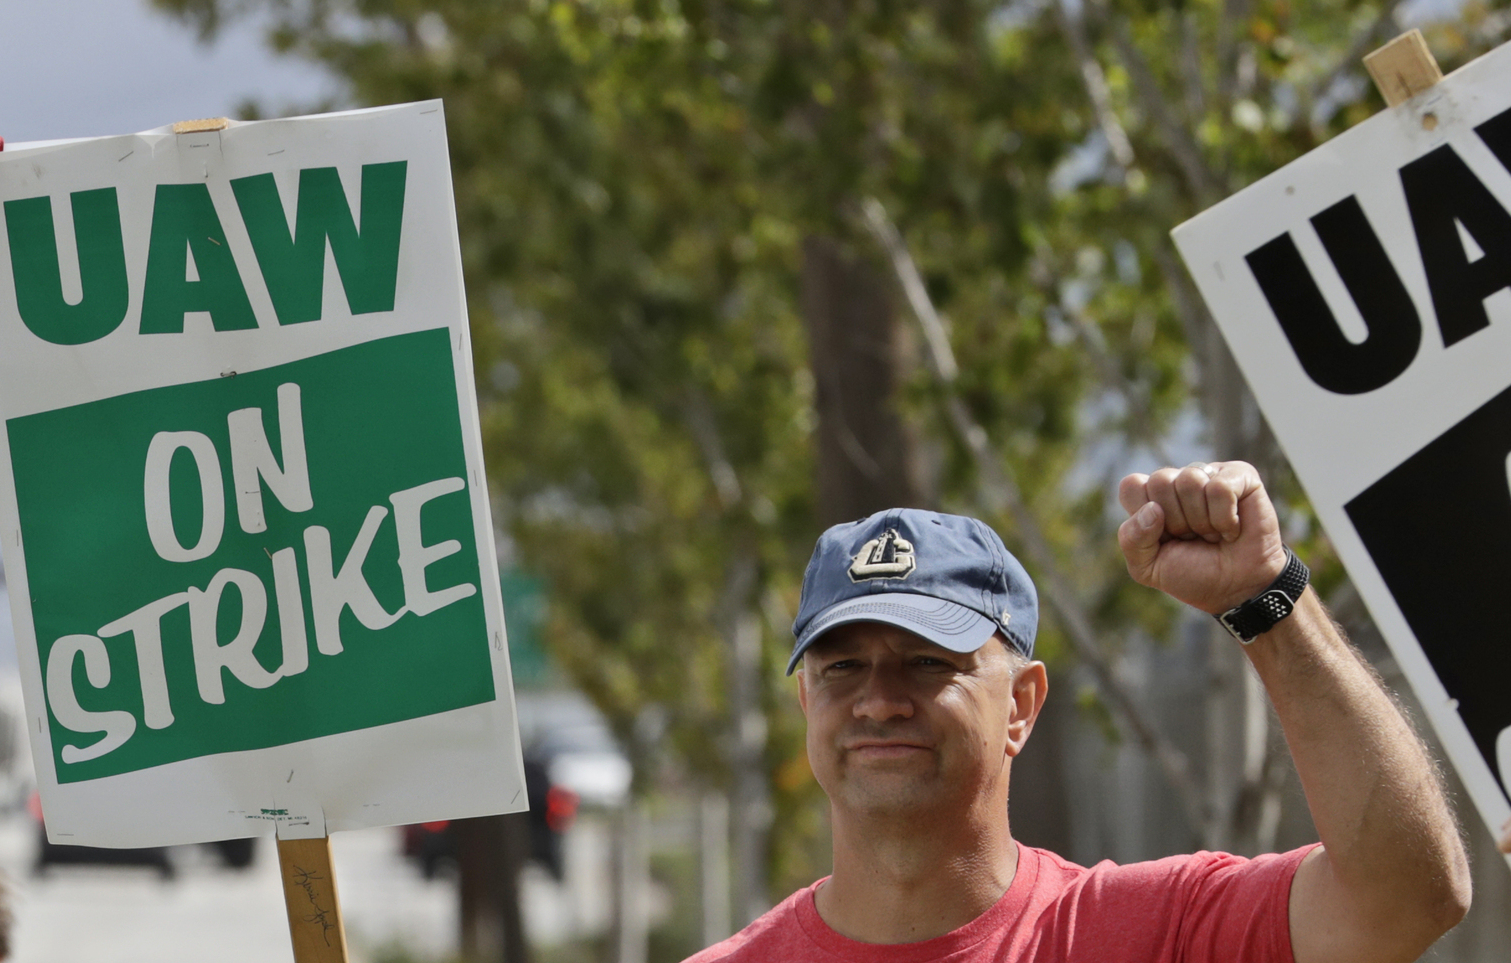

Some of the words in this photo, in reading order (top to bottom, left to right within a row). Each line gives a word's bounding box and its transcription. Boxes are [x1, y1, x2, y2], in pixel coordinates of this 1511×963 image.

[3, 160, 407, 346] UAW
[1243, 106, 1511, 396] UA
[143, 382, 313, 564] ON
[45, 476, 477, 765] STRIKE
